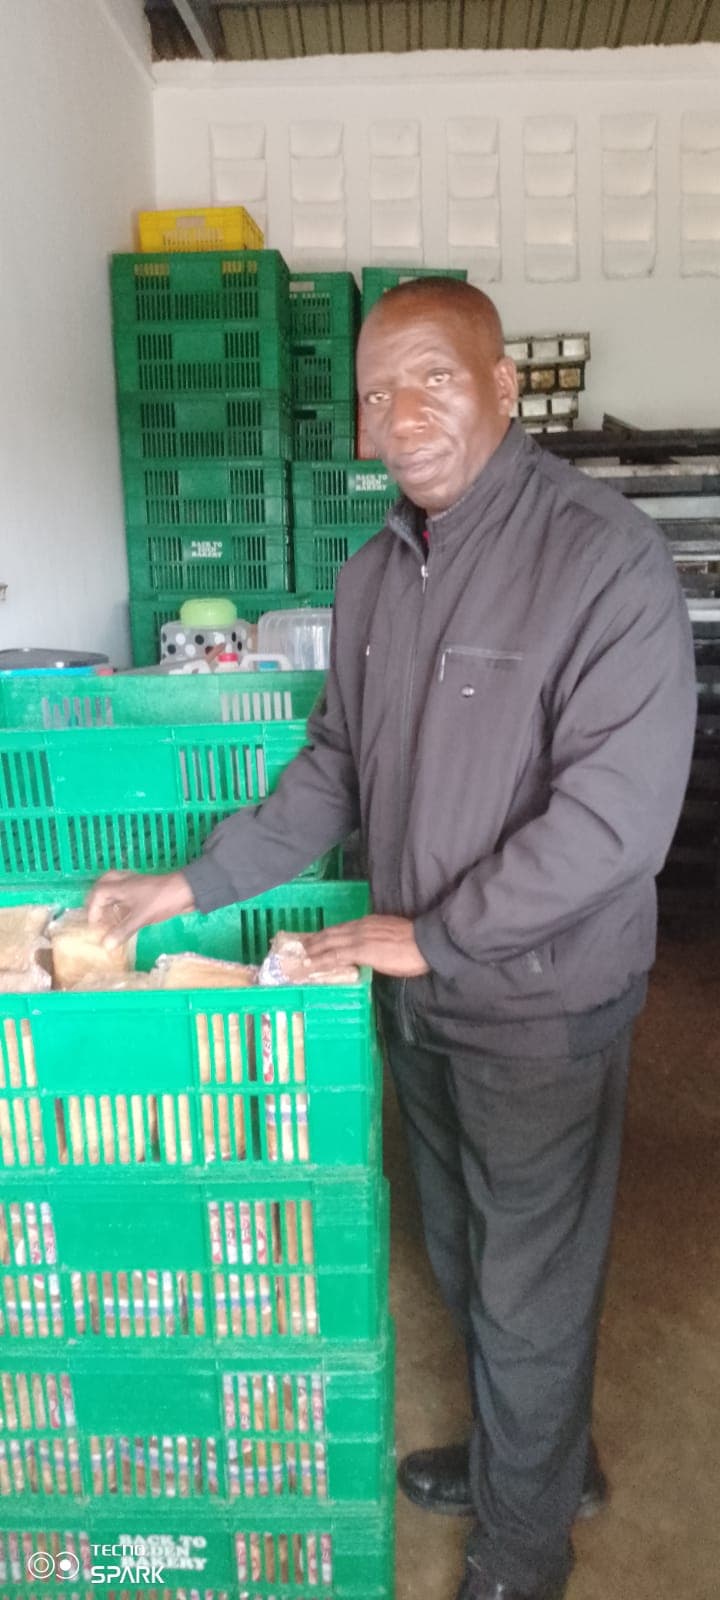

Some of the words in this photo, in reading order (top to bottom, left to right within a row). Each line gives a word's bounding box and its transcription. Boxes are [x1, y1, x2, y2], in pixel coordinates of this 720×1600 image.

[119, 1534, 175, 1547] BACK
[179, 1535, 207, 1548] TO
[121, 1556, 207, 1571] BAKERY
